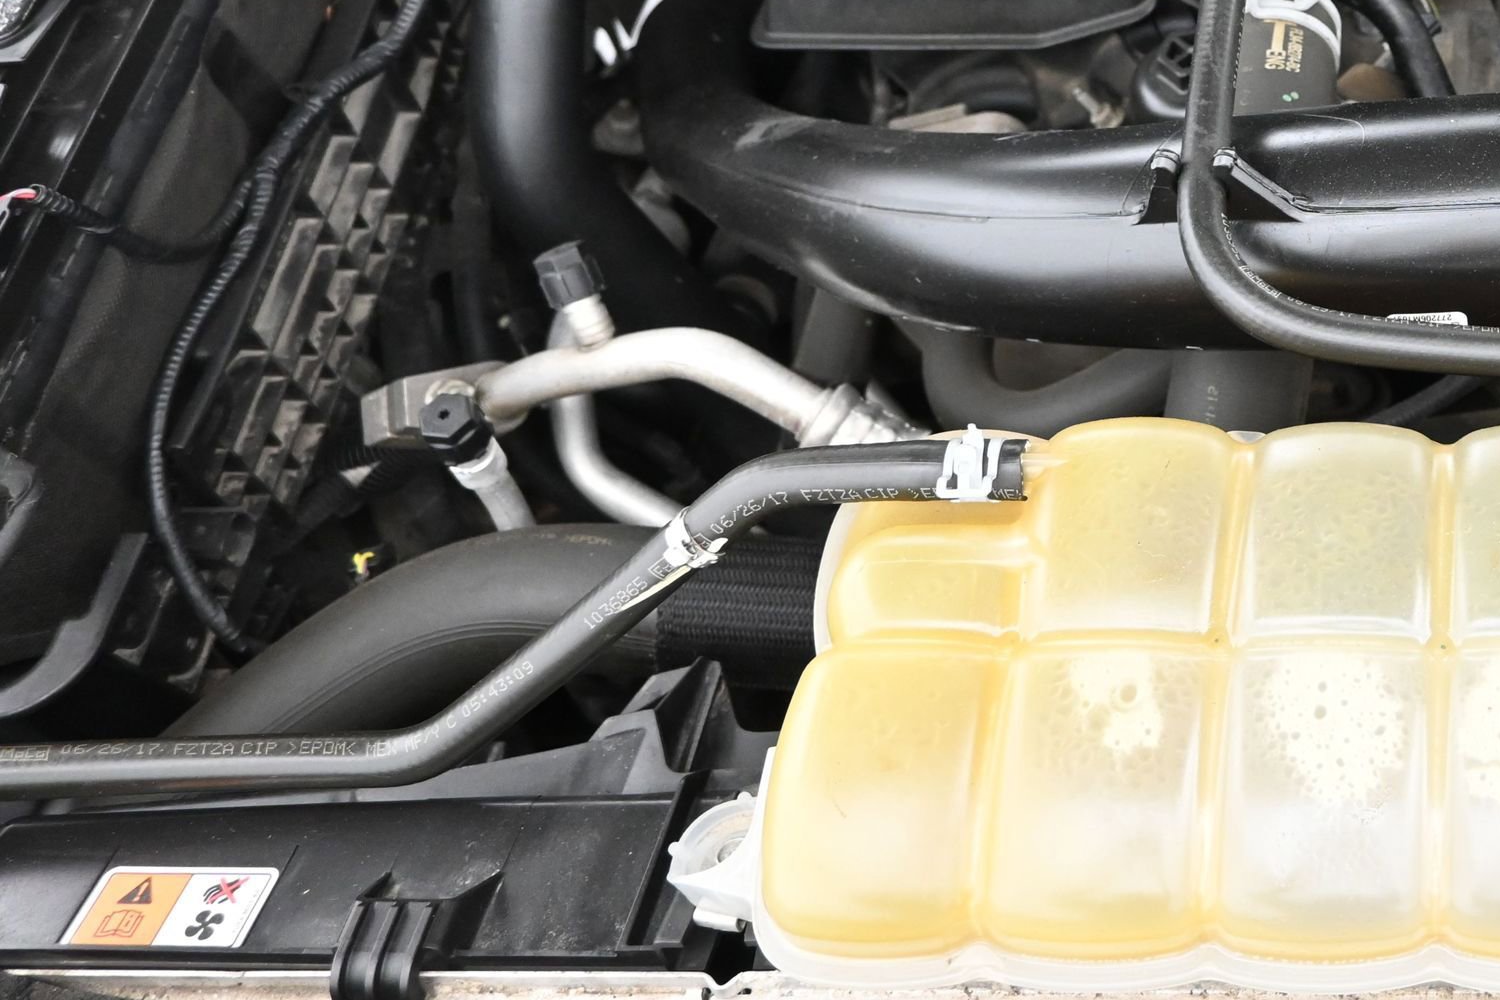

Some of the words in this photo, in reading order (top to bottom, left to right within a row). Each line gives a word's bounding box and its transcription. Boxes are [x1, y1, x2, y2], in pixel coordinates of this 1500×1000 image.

[1264, 49, 1287, 70] ENG
[61, 743, 160, 755] 06/26/17
[240, 742, 278, 755] CIP
[286, 741, 357, 756] >EPDM<
[461, 660, 534, 718] 05:43:09
[583, 575, 648, 630] 1036865
[710, 491, 788, 535] 06/26/17
[864, 488, 899, 500] CIP
